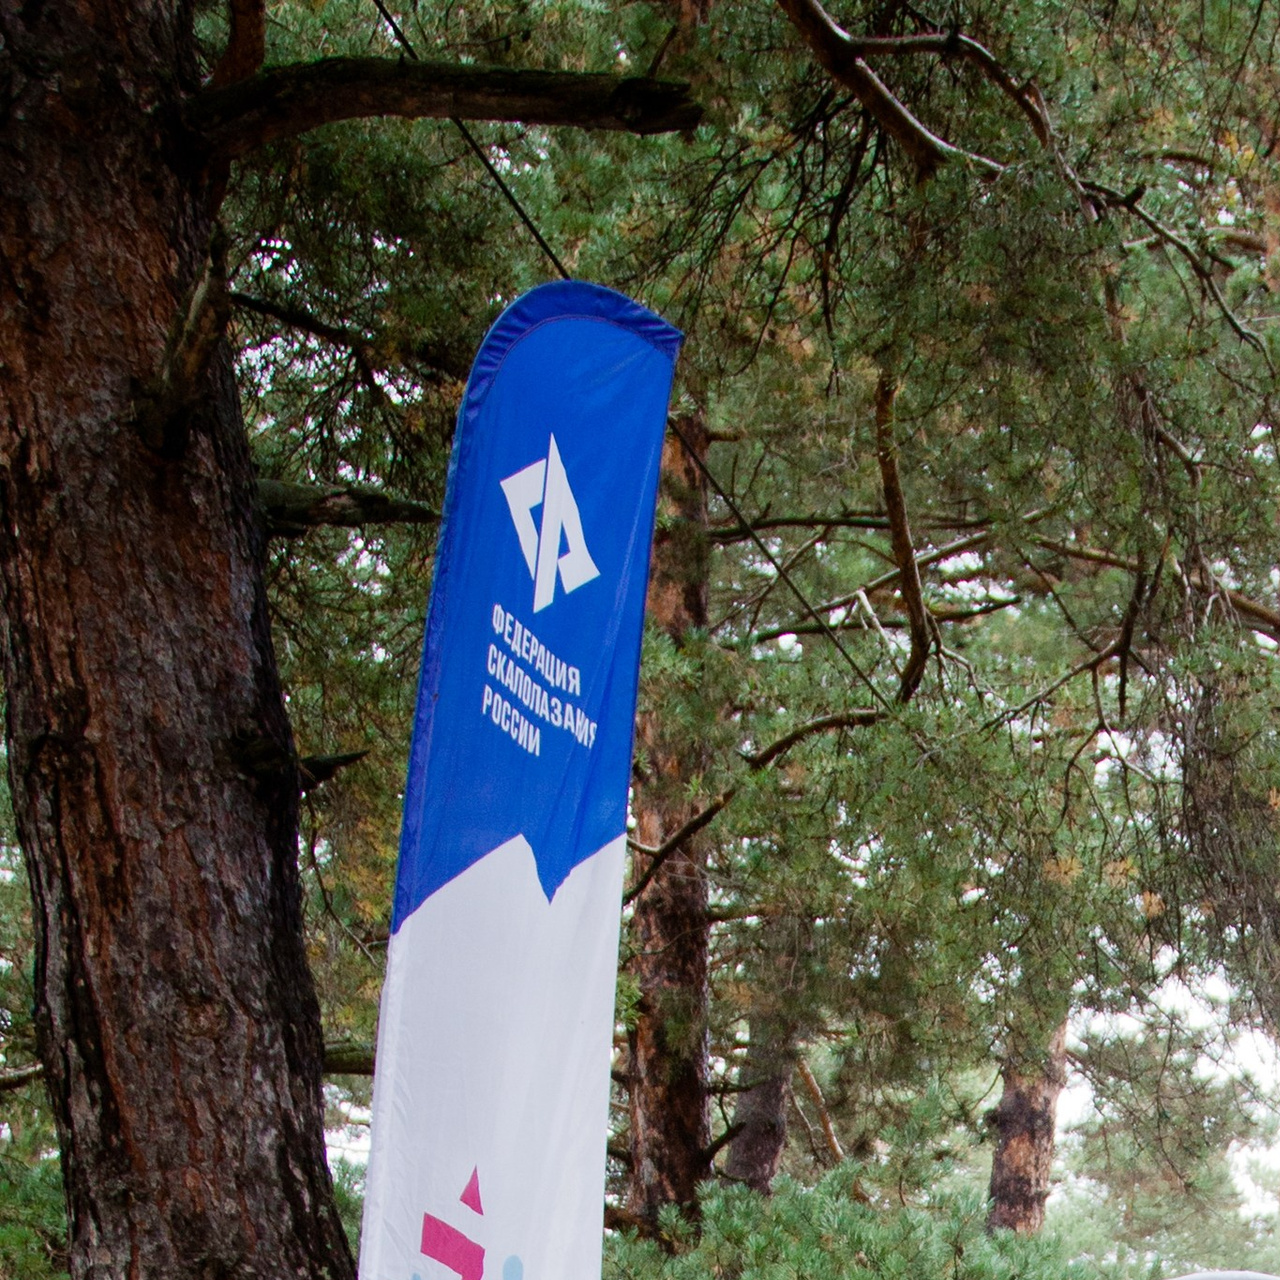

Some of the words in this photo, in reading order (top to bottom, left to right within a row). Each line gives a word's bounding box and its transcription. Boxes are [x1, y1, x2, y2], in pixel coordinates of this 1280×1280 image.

[487, 643, 598, 750] СКАЛОЛАЗАНИЯ
[492, 603, 581, 697] ФЕДЕРАЦИЯ
[482, 684, 541, 757] РОССИИ
